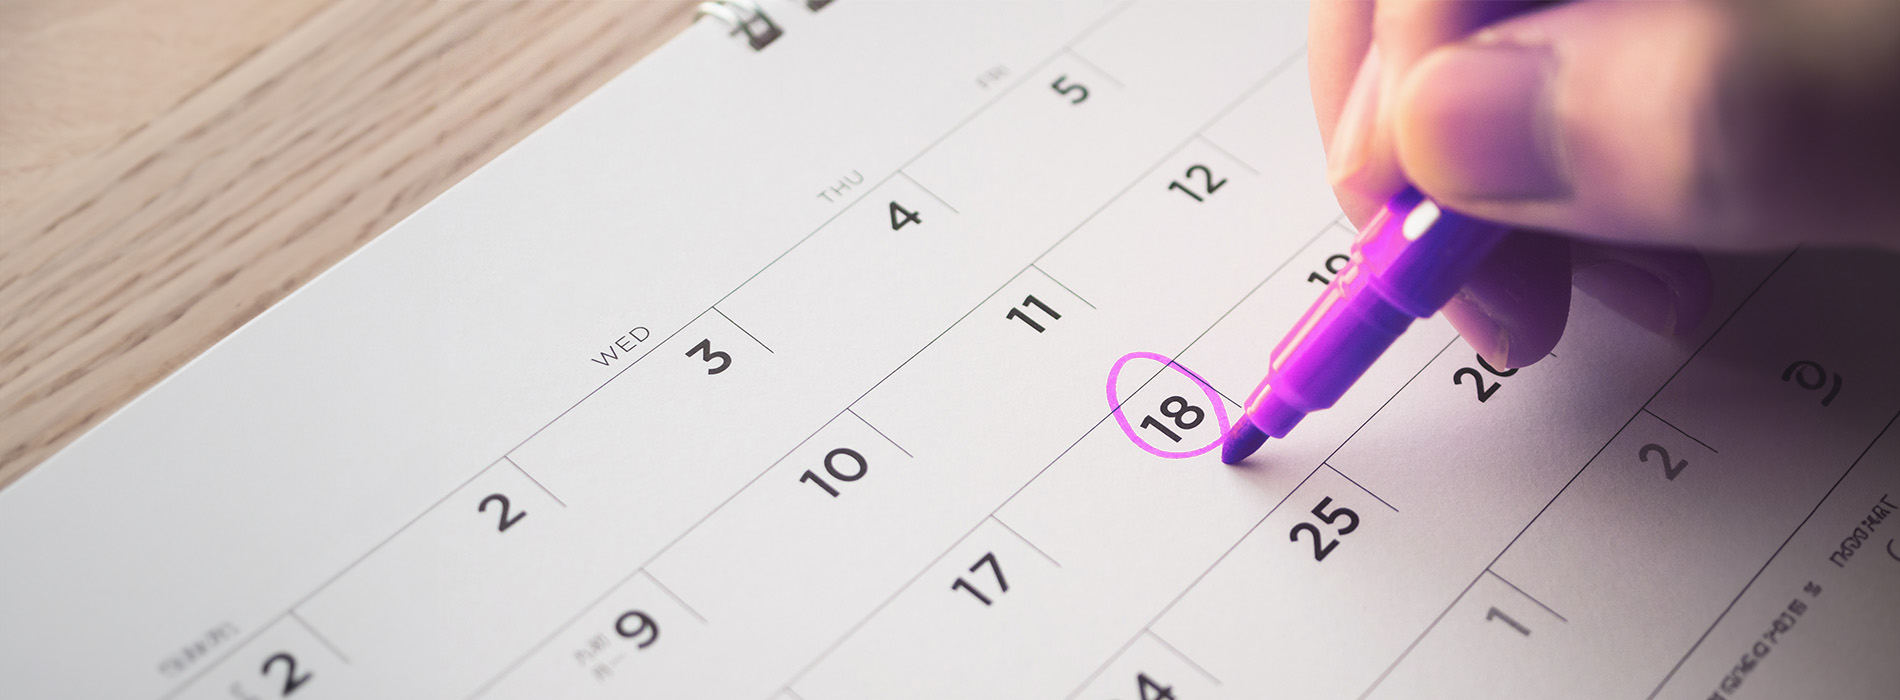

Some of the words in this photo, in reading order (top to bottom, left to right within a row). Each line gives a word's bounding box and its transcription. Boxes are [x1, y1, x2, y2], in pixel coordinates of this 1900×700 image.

[1050, 75, 1091, 105] 5
[816, 169, 866, 204] THU
[1168, 164, 1229, 204] 12
[889, 201, 923, 232] 4
[1005, 294, 1063, 334] 11
[590, 326, 651, 367] WED
[684, 338, 733, 376] 3
[1139, 394, 1206, 444] 18
[799, 440, 869, 499] 10
[1637, 440, 1690, 482] 2
[476, 492, 528, 534] 2
[1288, 495, 1361, 562] 25
[950, 551, 1010, 607] 17
[614, 609, 661, 650] 9
[1484, 604, 1533, 637] 1
[260, 651, 315, 698] 2
